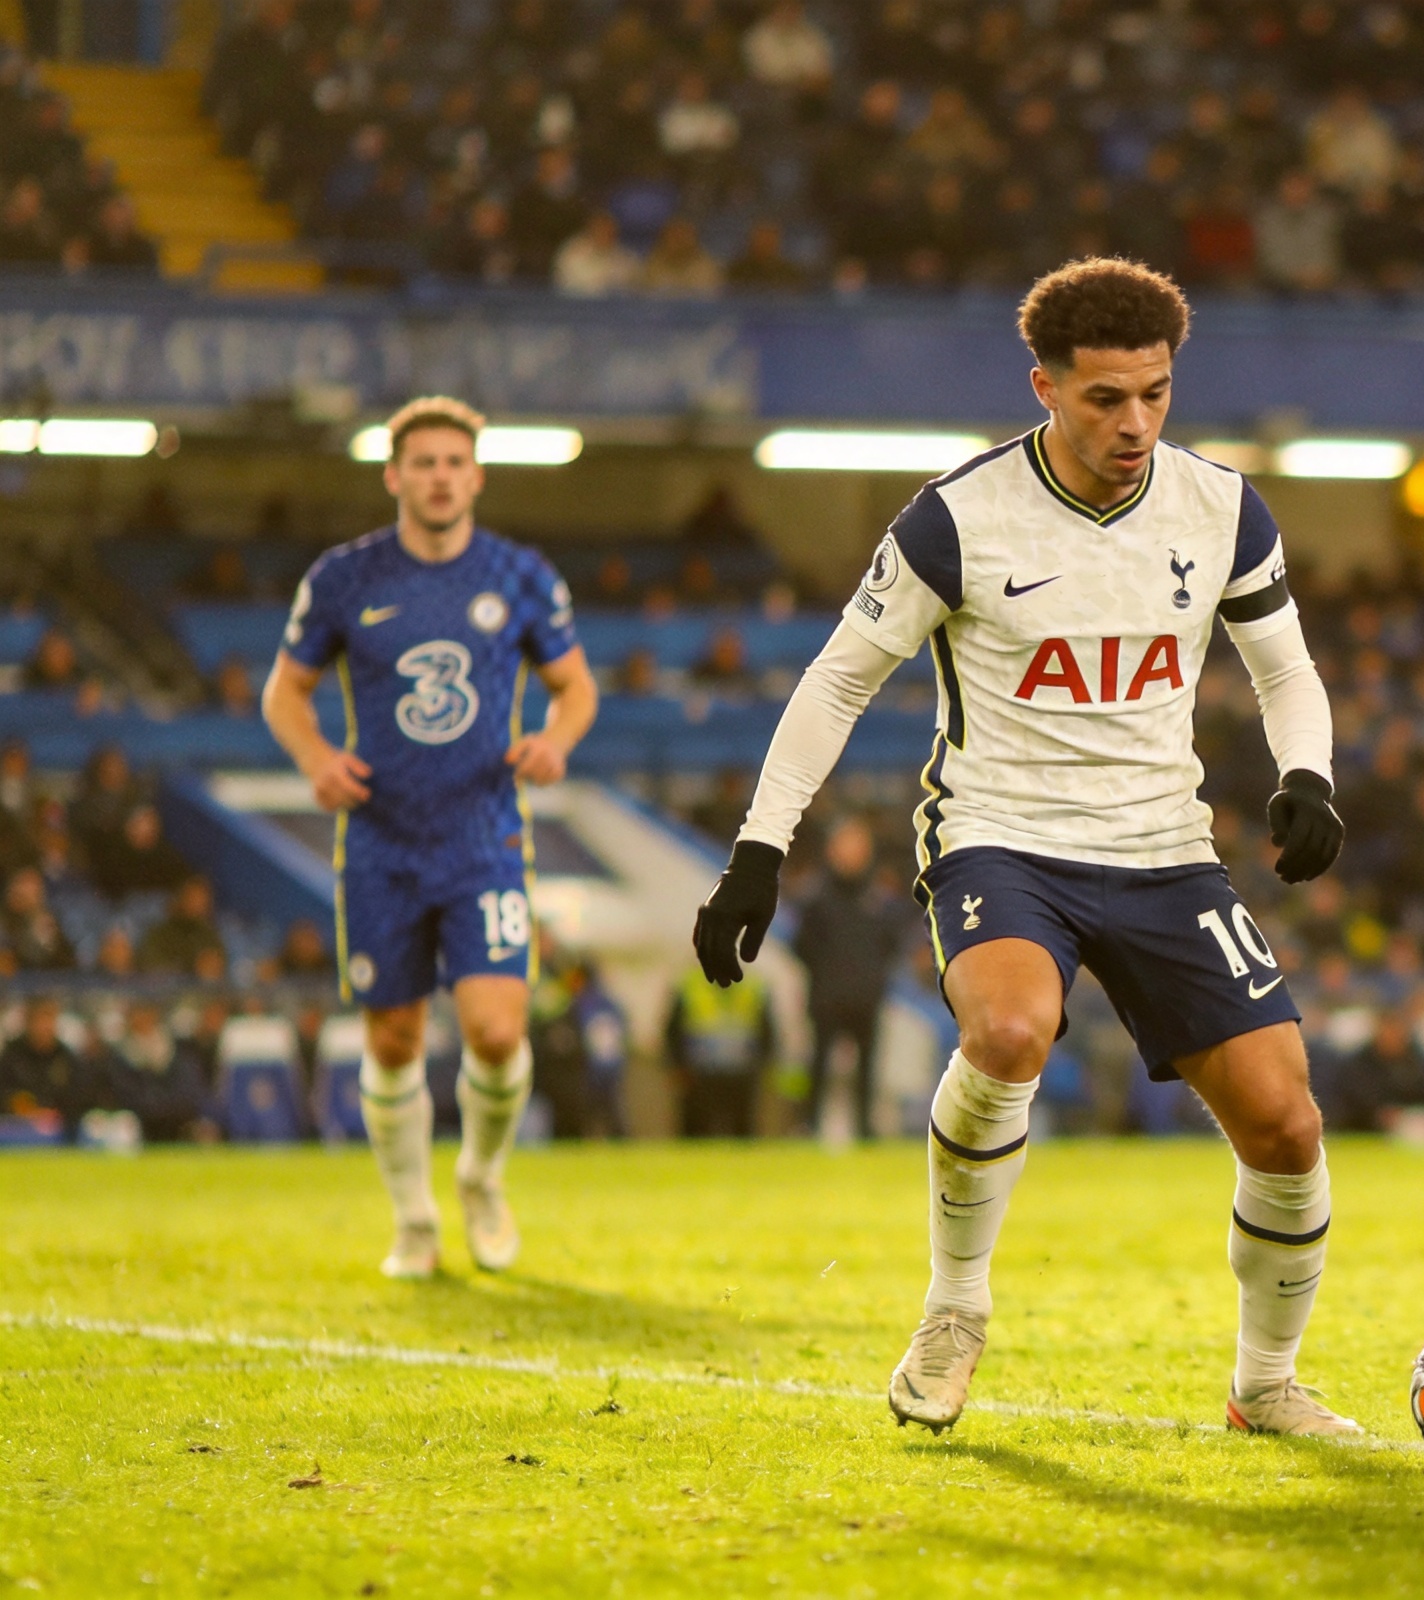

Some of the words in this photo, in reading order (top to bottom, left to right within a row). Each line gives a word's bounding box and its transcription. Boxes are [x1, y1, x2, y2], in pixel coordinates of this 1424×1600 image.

[395, 640, 479, 745] 3
[1013, 634, 1184, 704] AIA
[478, 889, 531, 947] 18
[1197, 902, 1278, 979] 10
